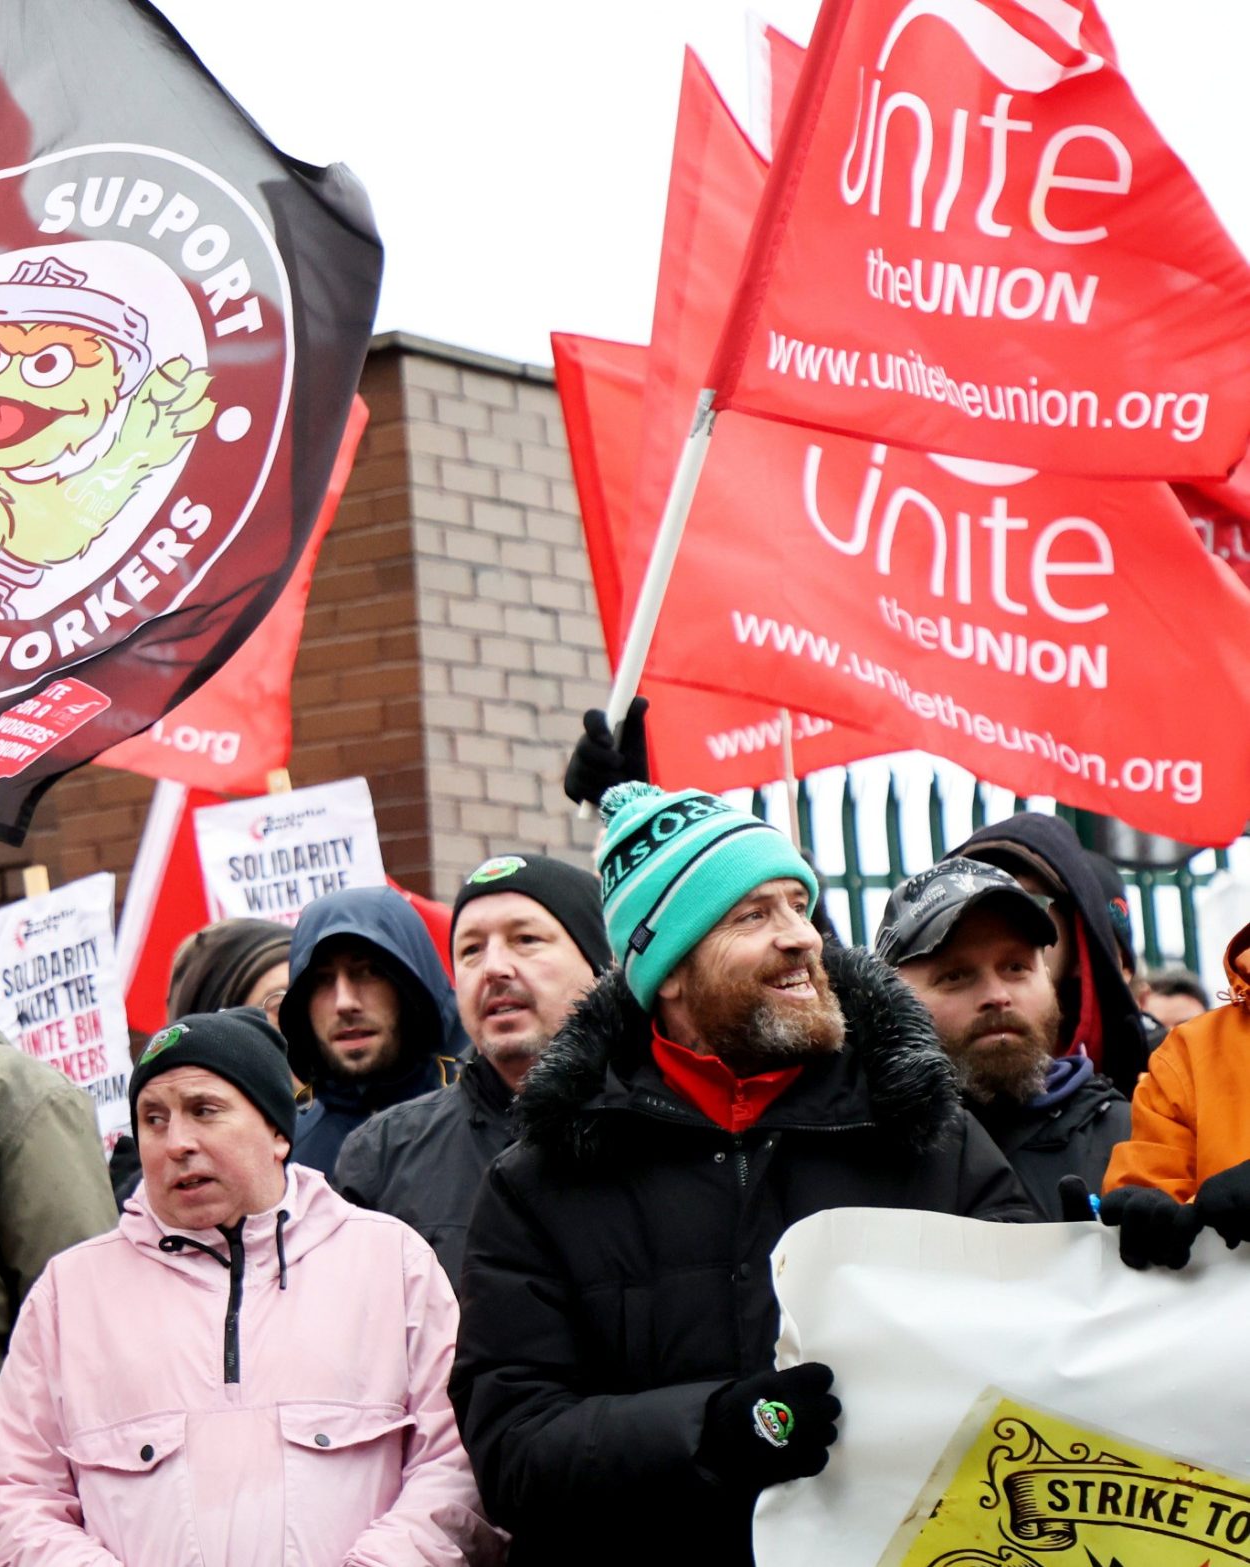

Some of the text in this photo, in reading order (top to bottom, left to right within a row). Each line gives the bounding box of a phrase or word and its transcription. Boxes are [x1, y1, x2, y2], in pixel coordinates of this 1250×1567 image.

[38, 176, 263, 339] SUPPORT
[867, 248, 1099, 324] theUNION
[879, 596, 1107, 688] theUNION
[731, 611, 1203, 804] www.unitetheunion.org
[228, 836, 354, 882] SOLIDARITY
[244, 871, 350, 911] WITH THE
[2, 937, 99, 997] SOLIDARITY
[61, 975, 98, 1012] THE
[74, 1009, 103, 1045] BIN
[1047, 1479, 1250, 1545] STRIKE TO
